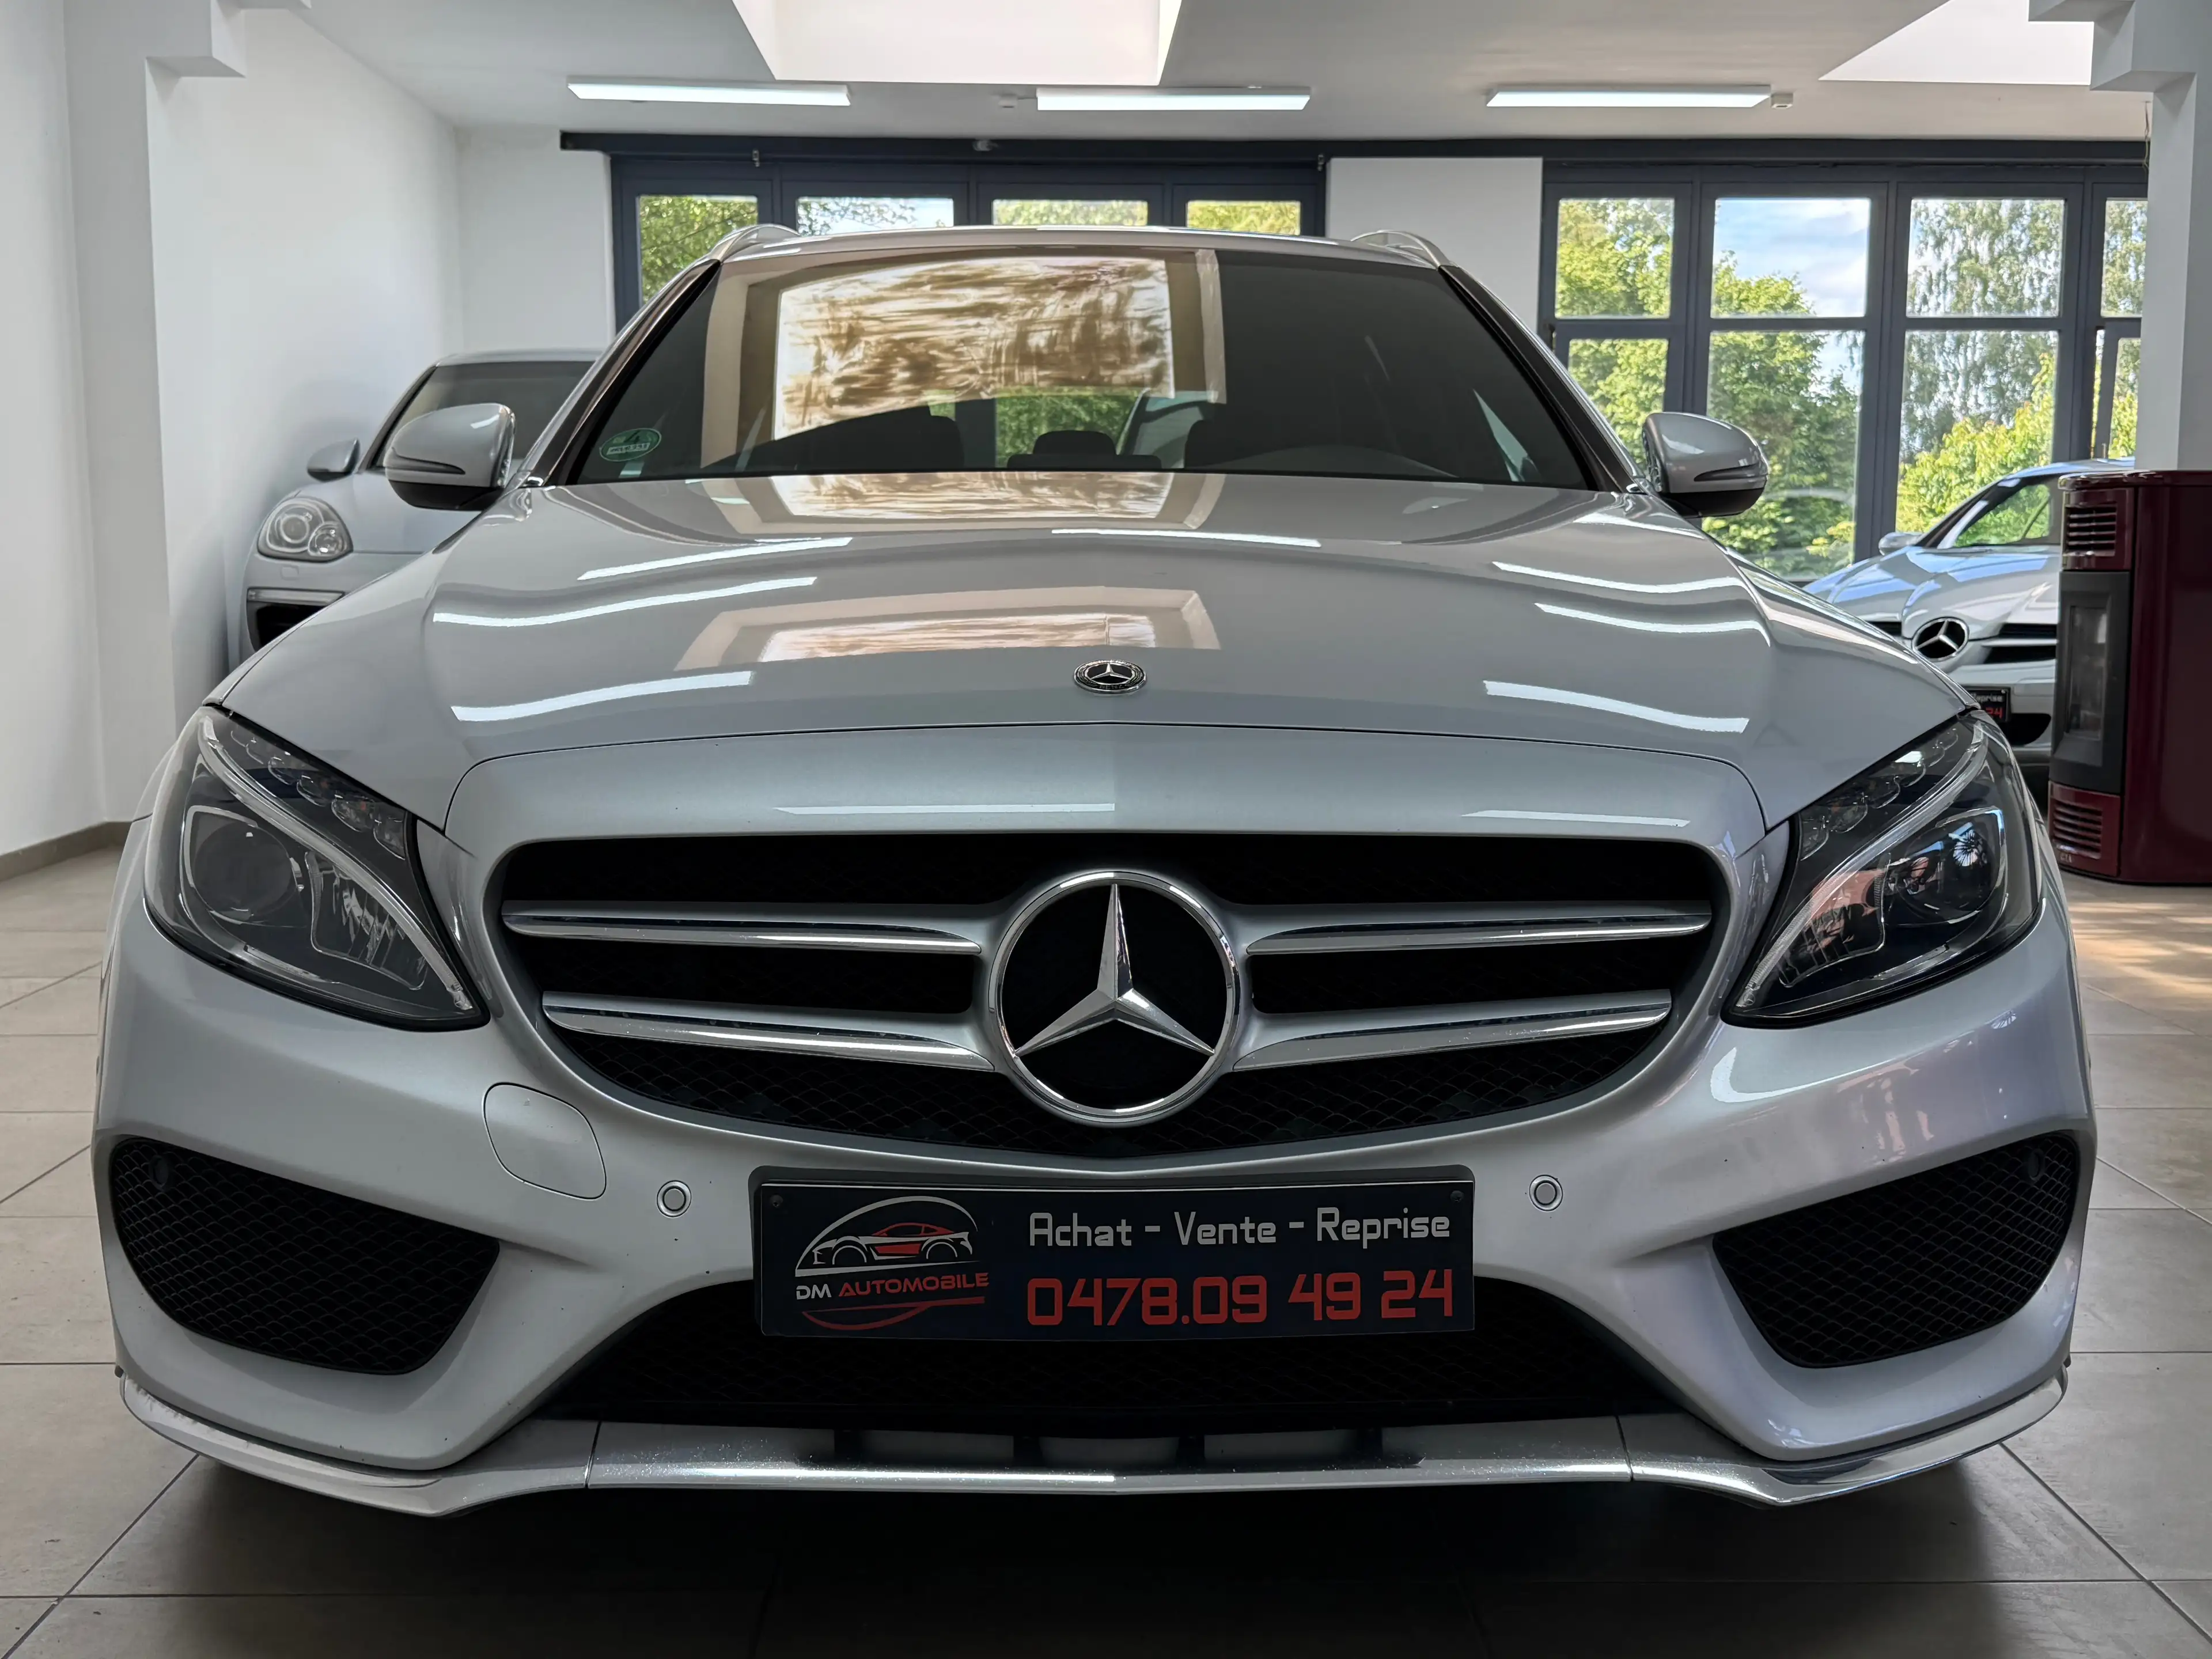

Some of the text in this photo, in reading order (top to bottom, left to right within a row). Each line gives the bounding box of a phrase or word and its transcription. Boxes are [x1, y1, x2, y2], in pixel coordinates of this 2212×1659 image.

[1029, 1212, 1132, 1247] Achat
[1173, 1211, 1277, 1245] Vente
[1317, 1207, 1450, 1249] Reprise
[796, 1272, 990, 1300] DM AUTOMOBILE
[1027, 1268, 1453, 1326] 0478.09 49 24
